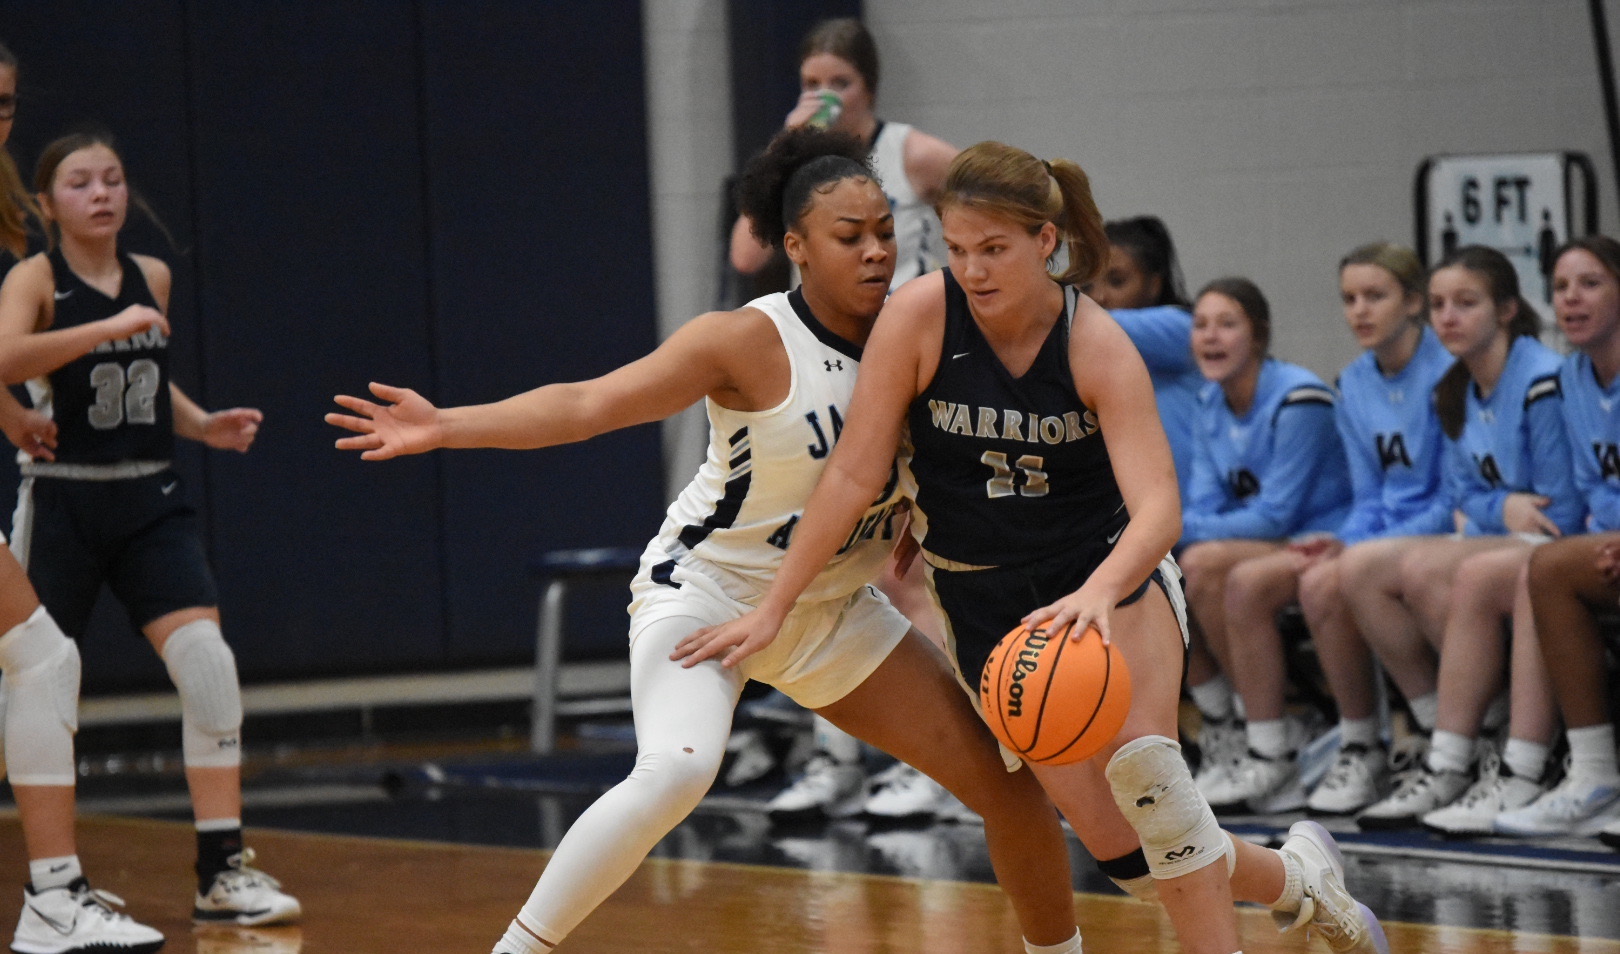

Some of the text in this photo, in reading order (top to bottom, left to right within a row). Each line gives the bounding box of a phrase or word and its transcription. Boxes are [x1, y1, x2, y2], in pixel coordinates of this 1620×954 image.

[1461, 175, 1531, 225] 6 FT
[88, 358, 160, 430] 32
[927, 399, 1100, 445] WARRIORS
[980, 450, 1050, 499] 11
[1007, 628, 1049, 718] Wilson
